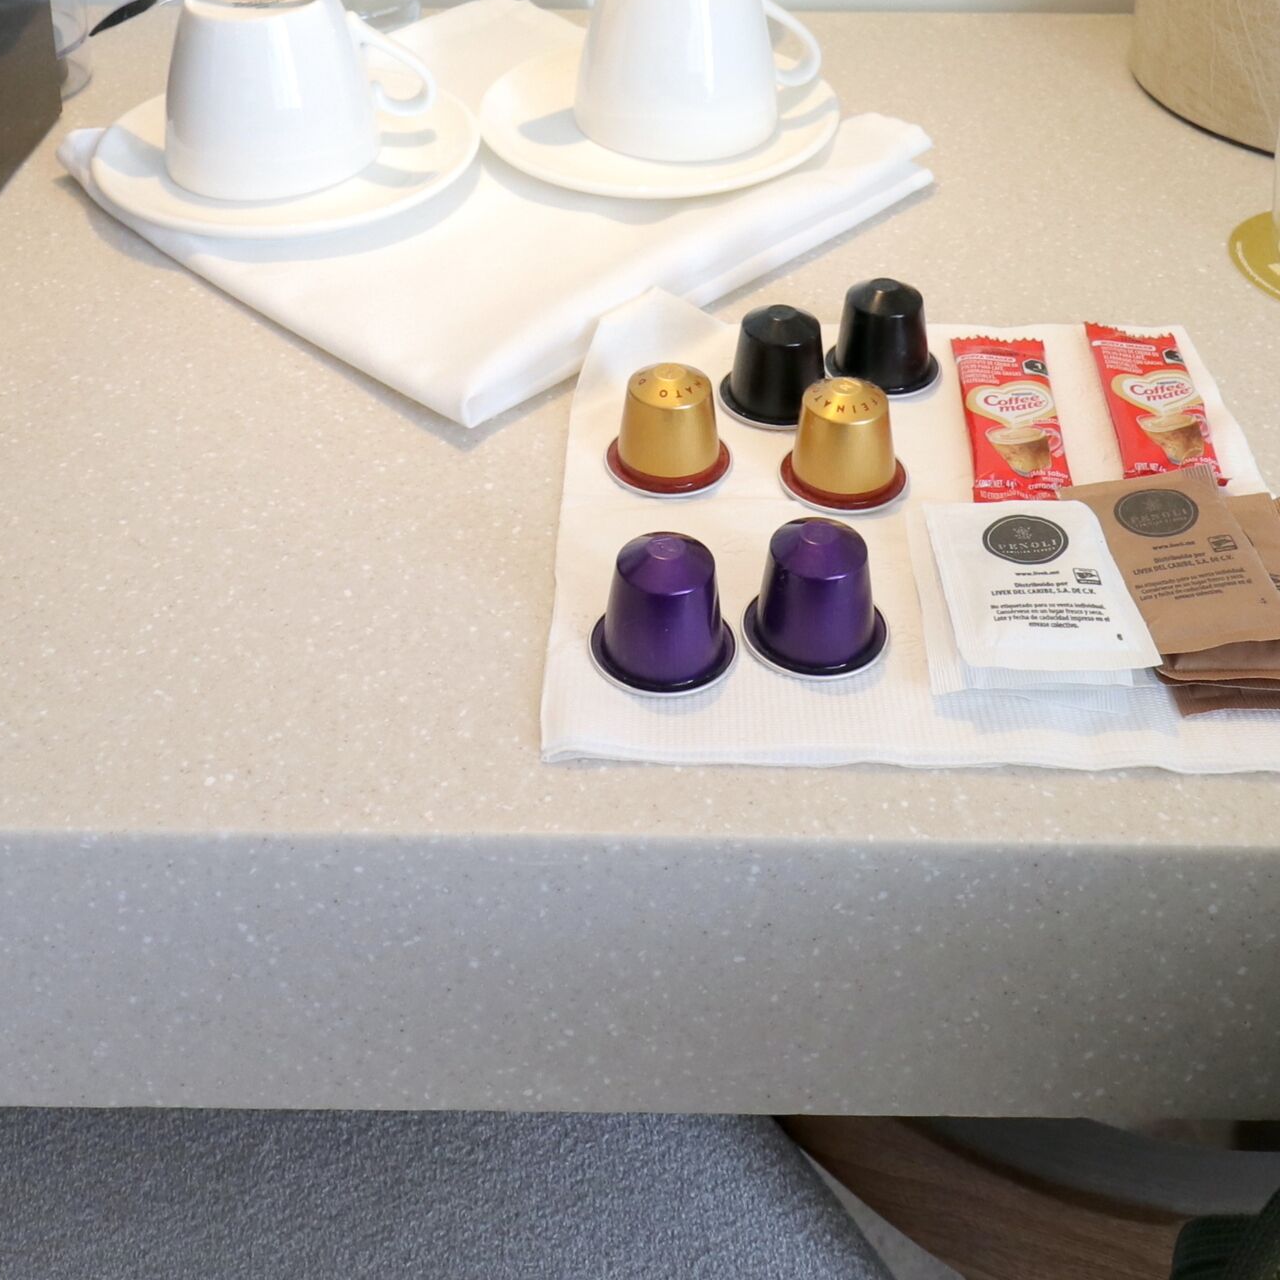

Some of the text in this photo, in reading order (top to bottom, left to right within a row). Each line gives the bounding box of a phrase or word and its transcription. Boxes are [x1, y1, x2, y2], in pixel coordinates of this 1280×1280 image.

[1130, 383, 1185, 396] Coffee
[1146, 388, 1190, 401] mate
[983, 395, 1040, 407] Coffee
[999, 400, 1044, 412] mate
[1082, 587, 1096, 595] C.V.
